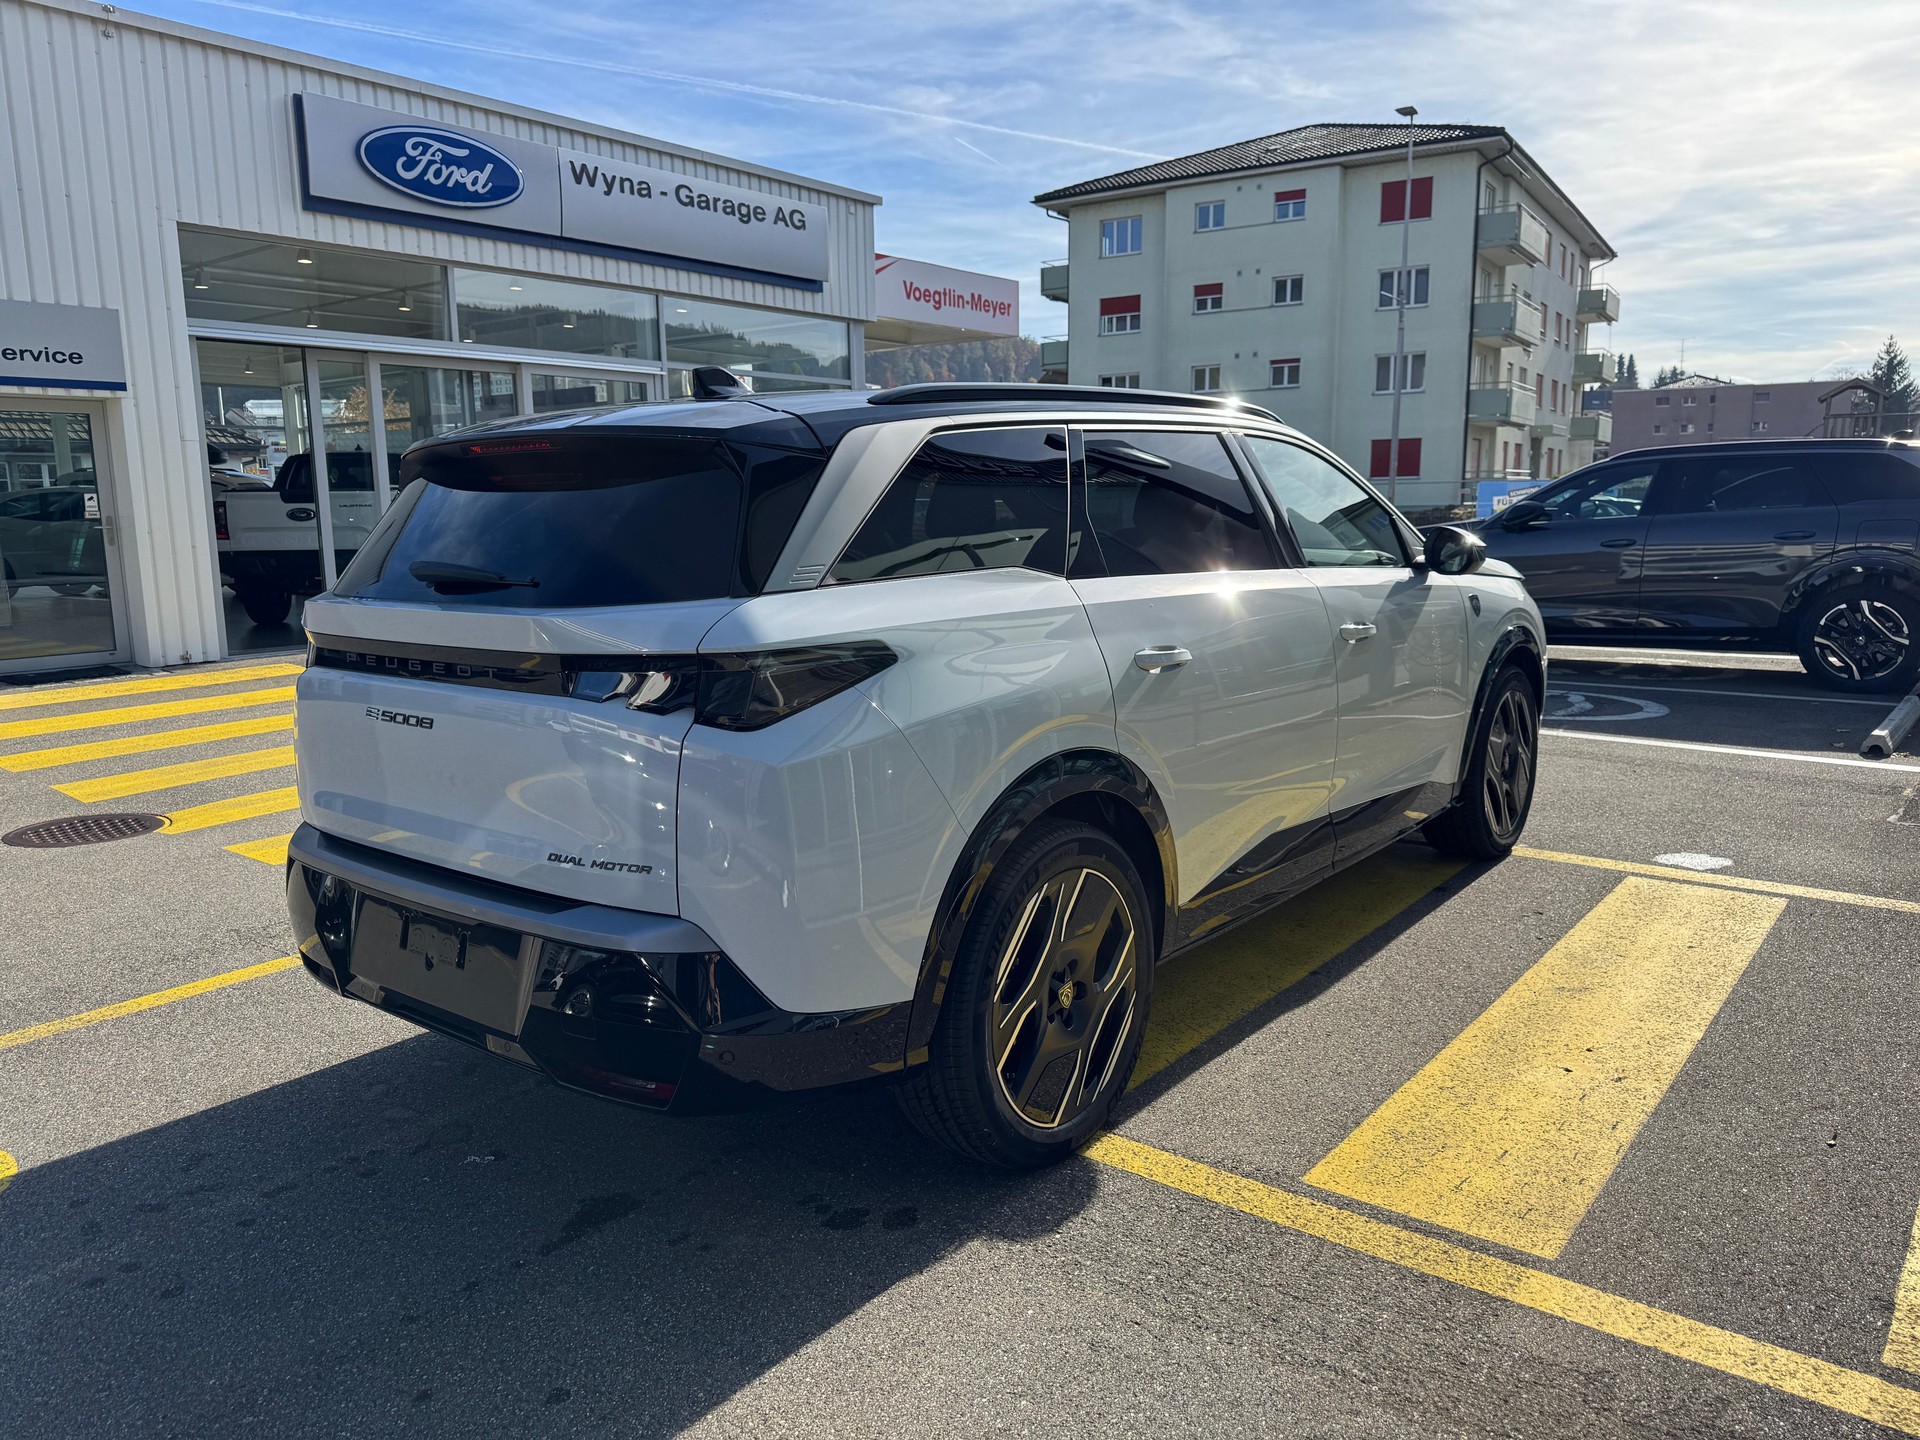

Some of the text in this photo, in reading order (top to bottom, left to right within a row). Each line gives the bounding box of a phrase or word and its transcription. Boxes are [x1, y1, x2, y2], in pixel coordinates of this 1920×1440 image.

[395, 136, 494, 194] Ford
[569, 160, 652, 199] Wyna
[674, 183, 767, 224] Garage
[773, 206, 807, 231] AG
[902, 279, 1013, 319] Voegtlin-Meyer
[1, 346, 84, 365] ervice
[346, 652, 498, 679] PEUGEOT
[546, 852, 653, 875] DUAL MOTOR
